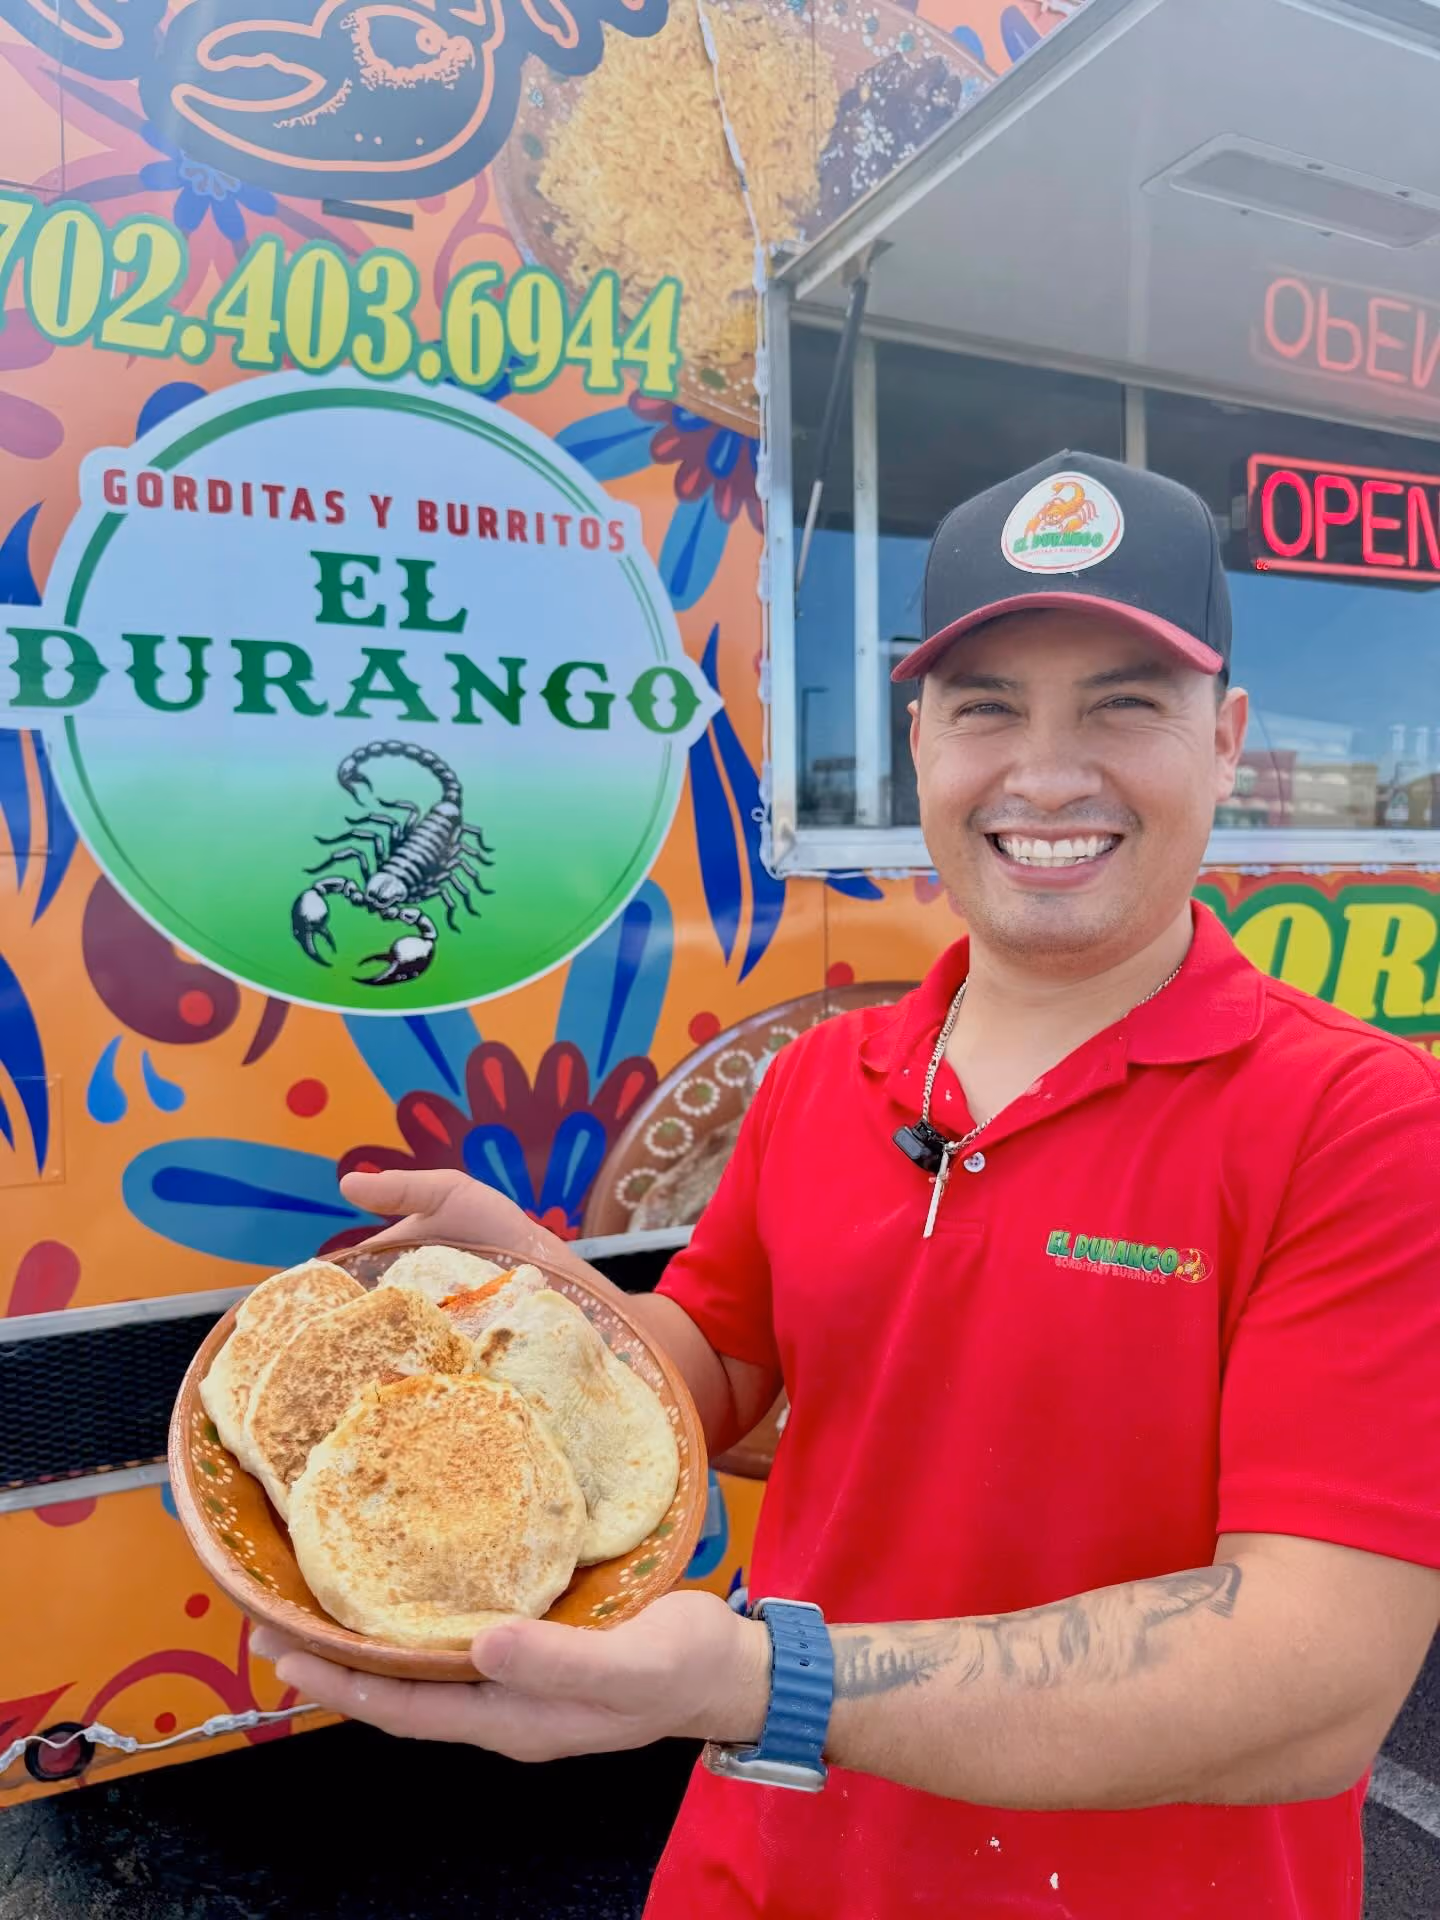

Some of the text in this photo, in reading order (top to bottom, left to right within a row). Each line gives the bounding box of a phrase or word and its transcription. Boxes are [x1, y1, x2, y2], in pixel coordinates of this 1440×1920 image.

[103, 468, 626, 553] GORDITAS Y BURRITOS
[1261, 470, 1440, 569] OPEN
[309, 550, 468, 634] EL
[5, 627, 703, 735] DURANGO
[1232, 903, 1440, 1021] OR
[1046, 1231, 1179, 1275] EL DURANGO
